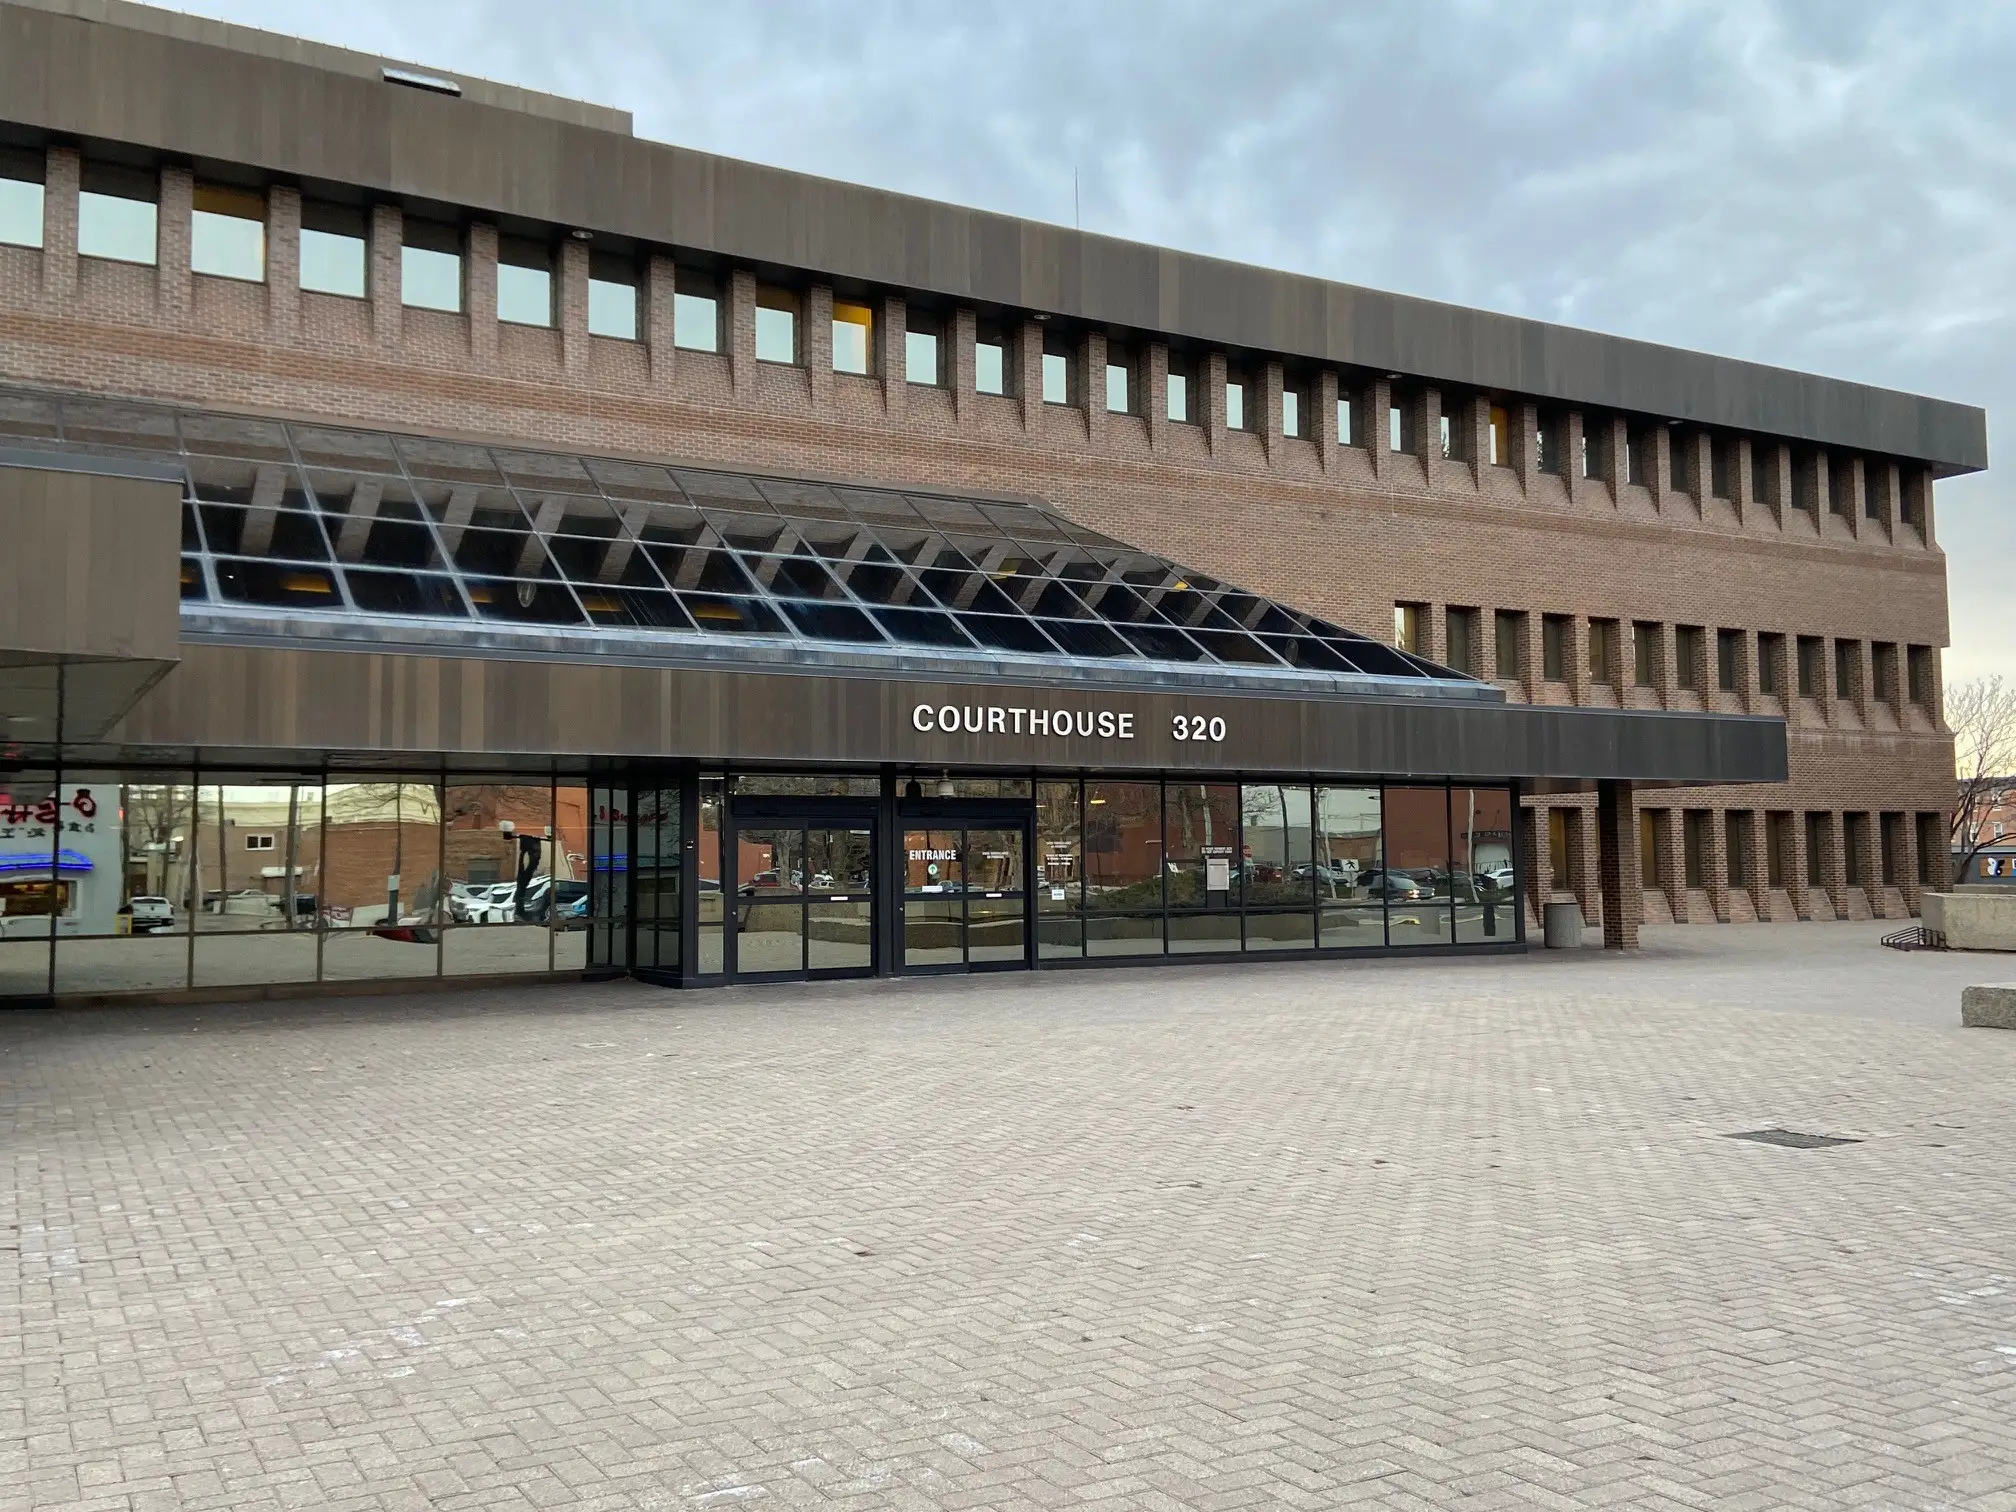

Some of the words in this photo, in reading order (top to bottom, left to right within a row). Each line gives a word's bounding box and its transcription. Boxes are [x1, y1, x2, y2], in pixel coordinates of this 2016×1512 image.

[912, 704, 1134, 738] COURTHOUSE
[1172, 715, 1227, 742] 320
[909, 849, 957, 861] ENTRANCE
